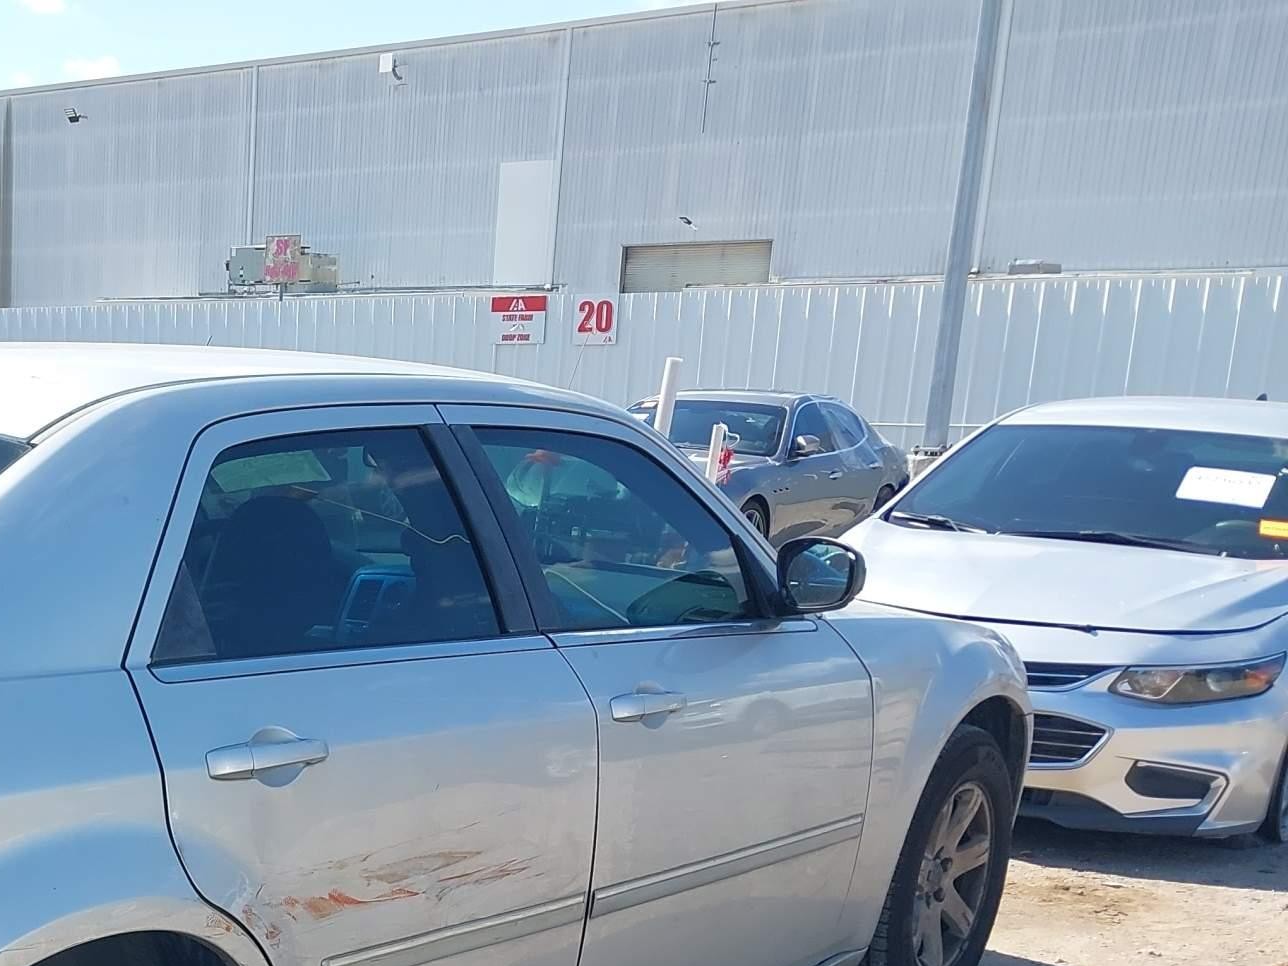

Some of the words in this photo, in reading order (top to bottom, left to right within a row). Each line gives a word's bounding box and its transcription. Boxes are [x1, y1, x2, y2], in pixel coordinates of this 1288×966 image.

[502, 314, 518, 322] STATE
[518, 313, 533, 321] FARM
[577, 300, 613, 332] 20
[501, 334, 517, 342] DROP
[516, 333, 531, 341] ZONE
